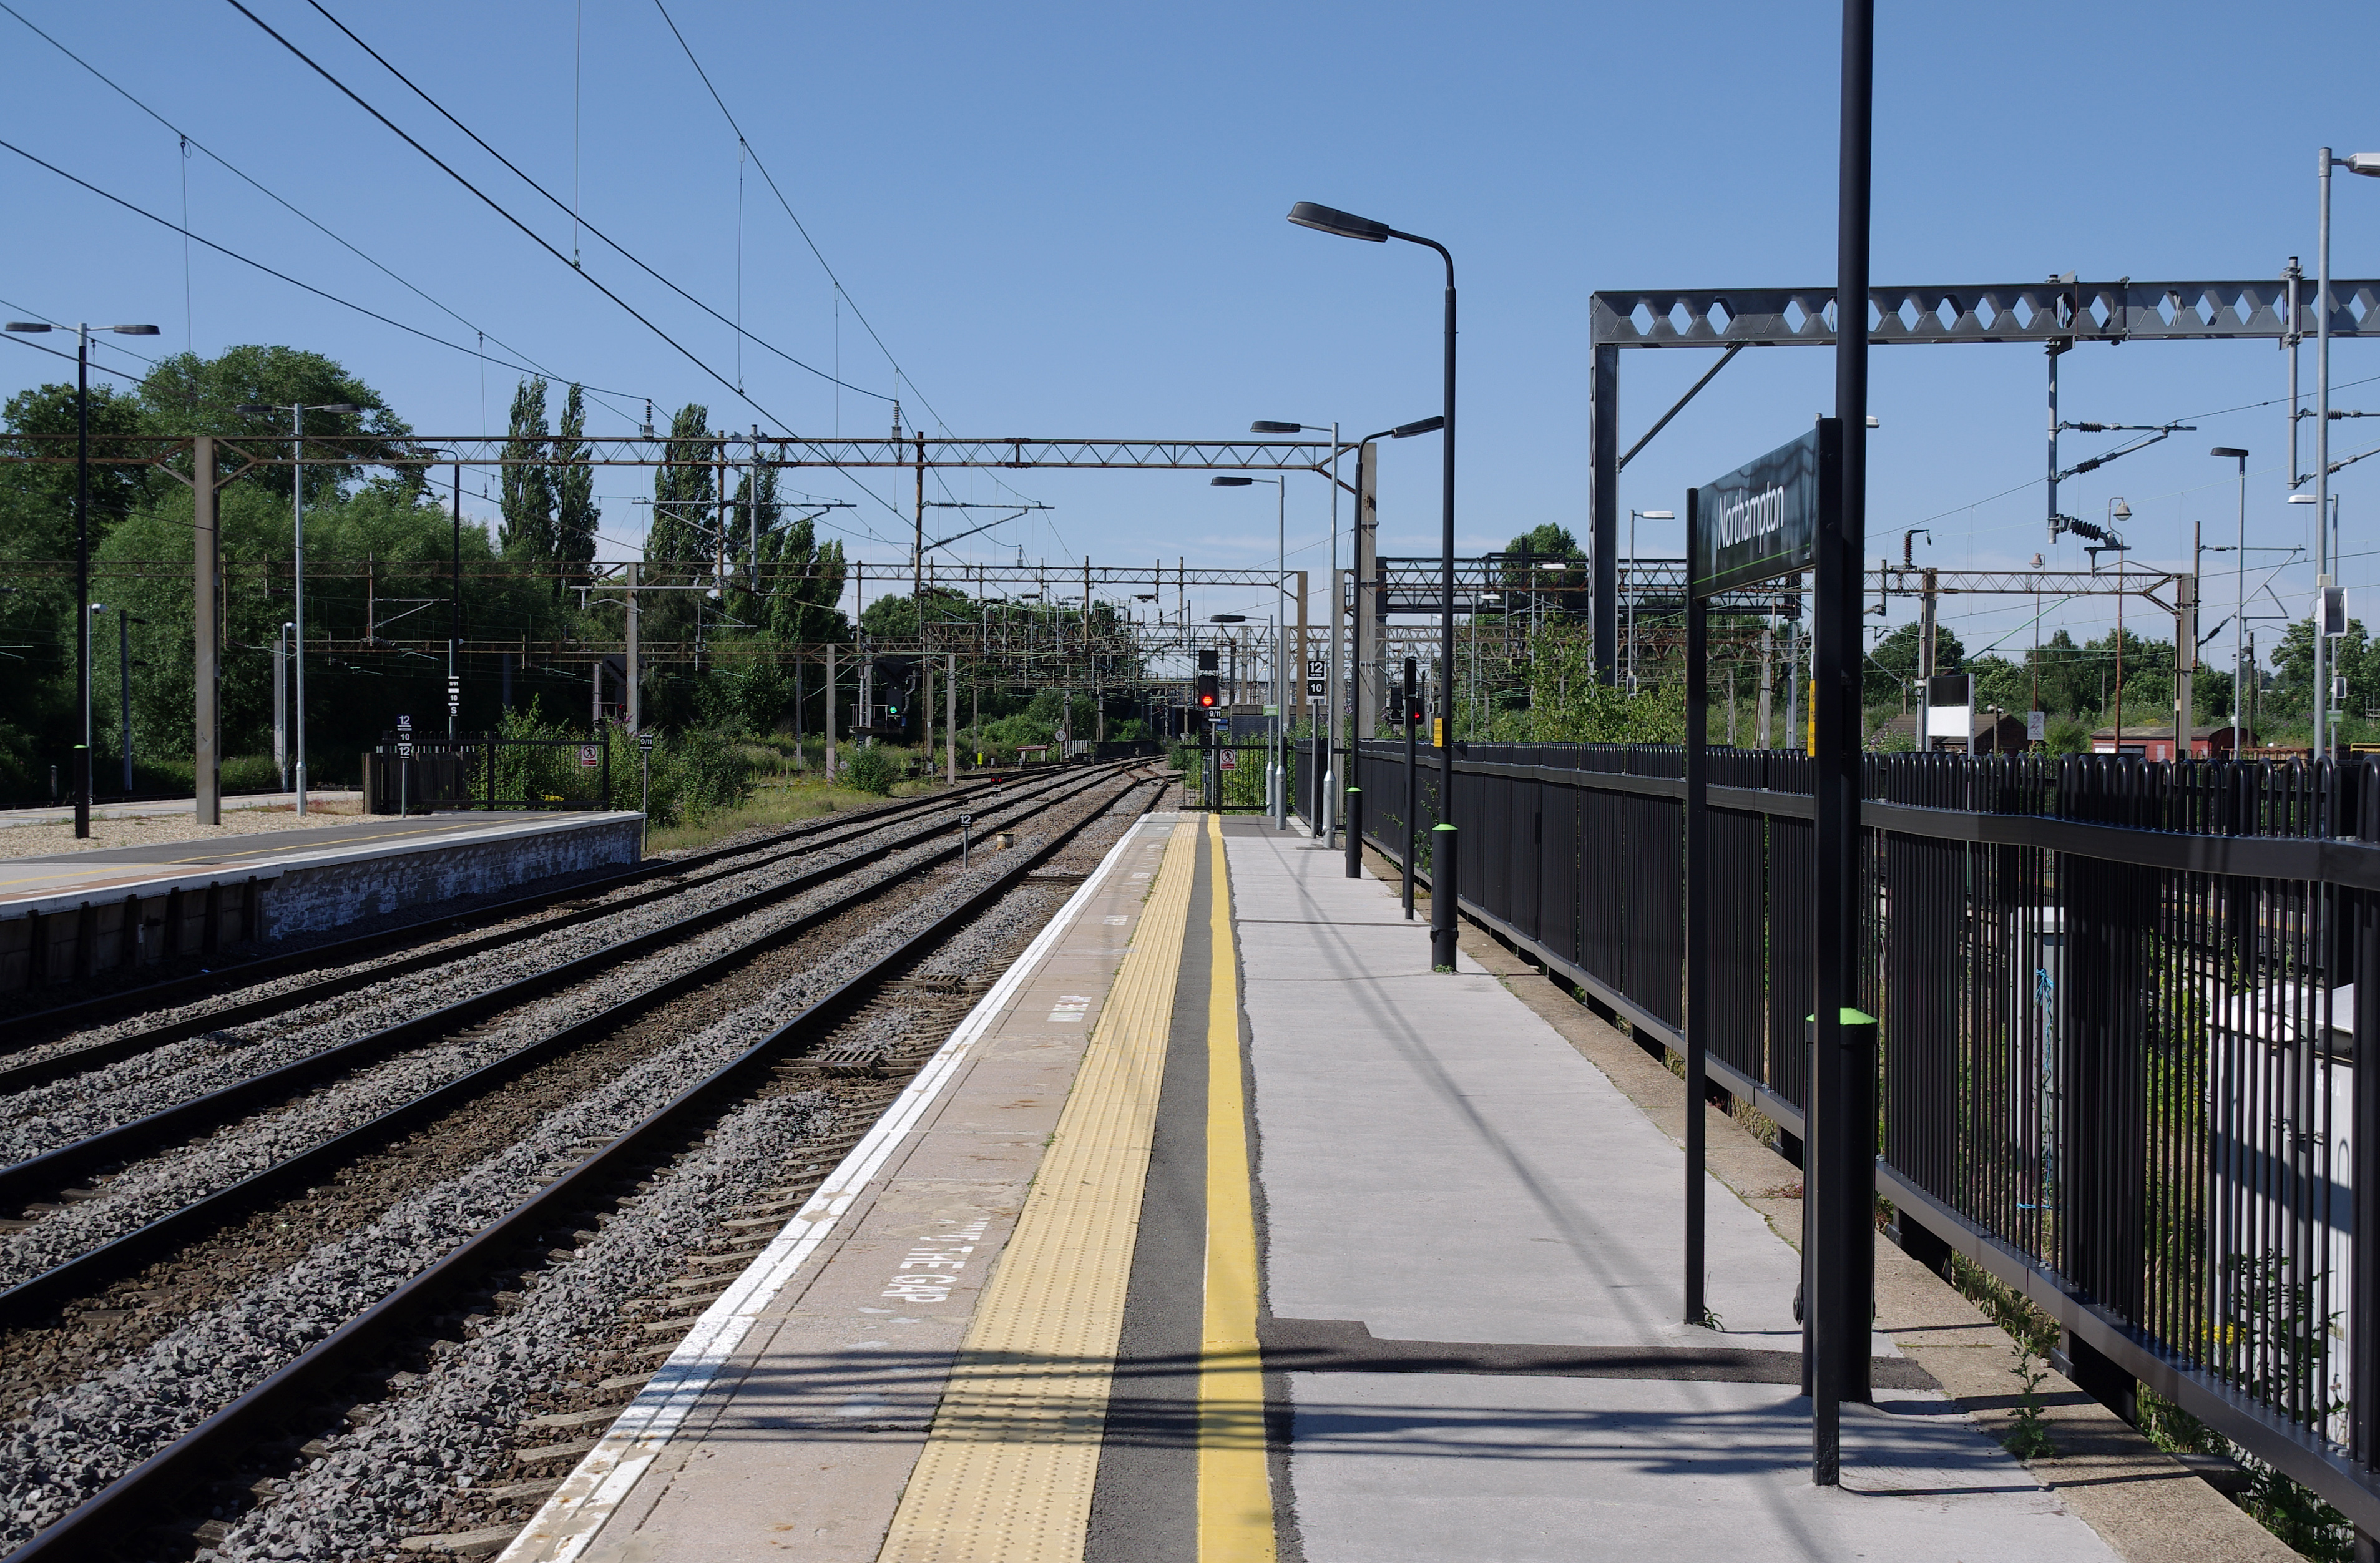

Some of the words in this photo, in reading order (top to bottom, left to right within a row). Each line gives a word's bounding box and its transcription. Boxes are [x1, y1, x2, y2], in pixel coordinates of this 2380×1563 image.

[1718, 481, 1783, 554] Northampton
[1310, 662, 1323, 673] 12
[1311, 684, 1322, 692] 10
[451, 706, 457, 714] S
[399, 715, 410, 725] 12
[399, 747, 410, 755] 12
[960, 815, 971, 824] 12
[899, 1246, 974, 1268] THE
[881, 1274, 958, 1303] GAP
